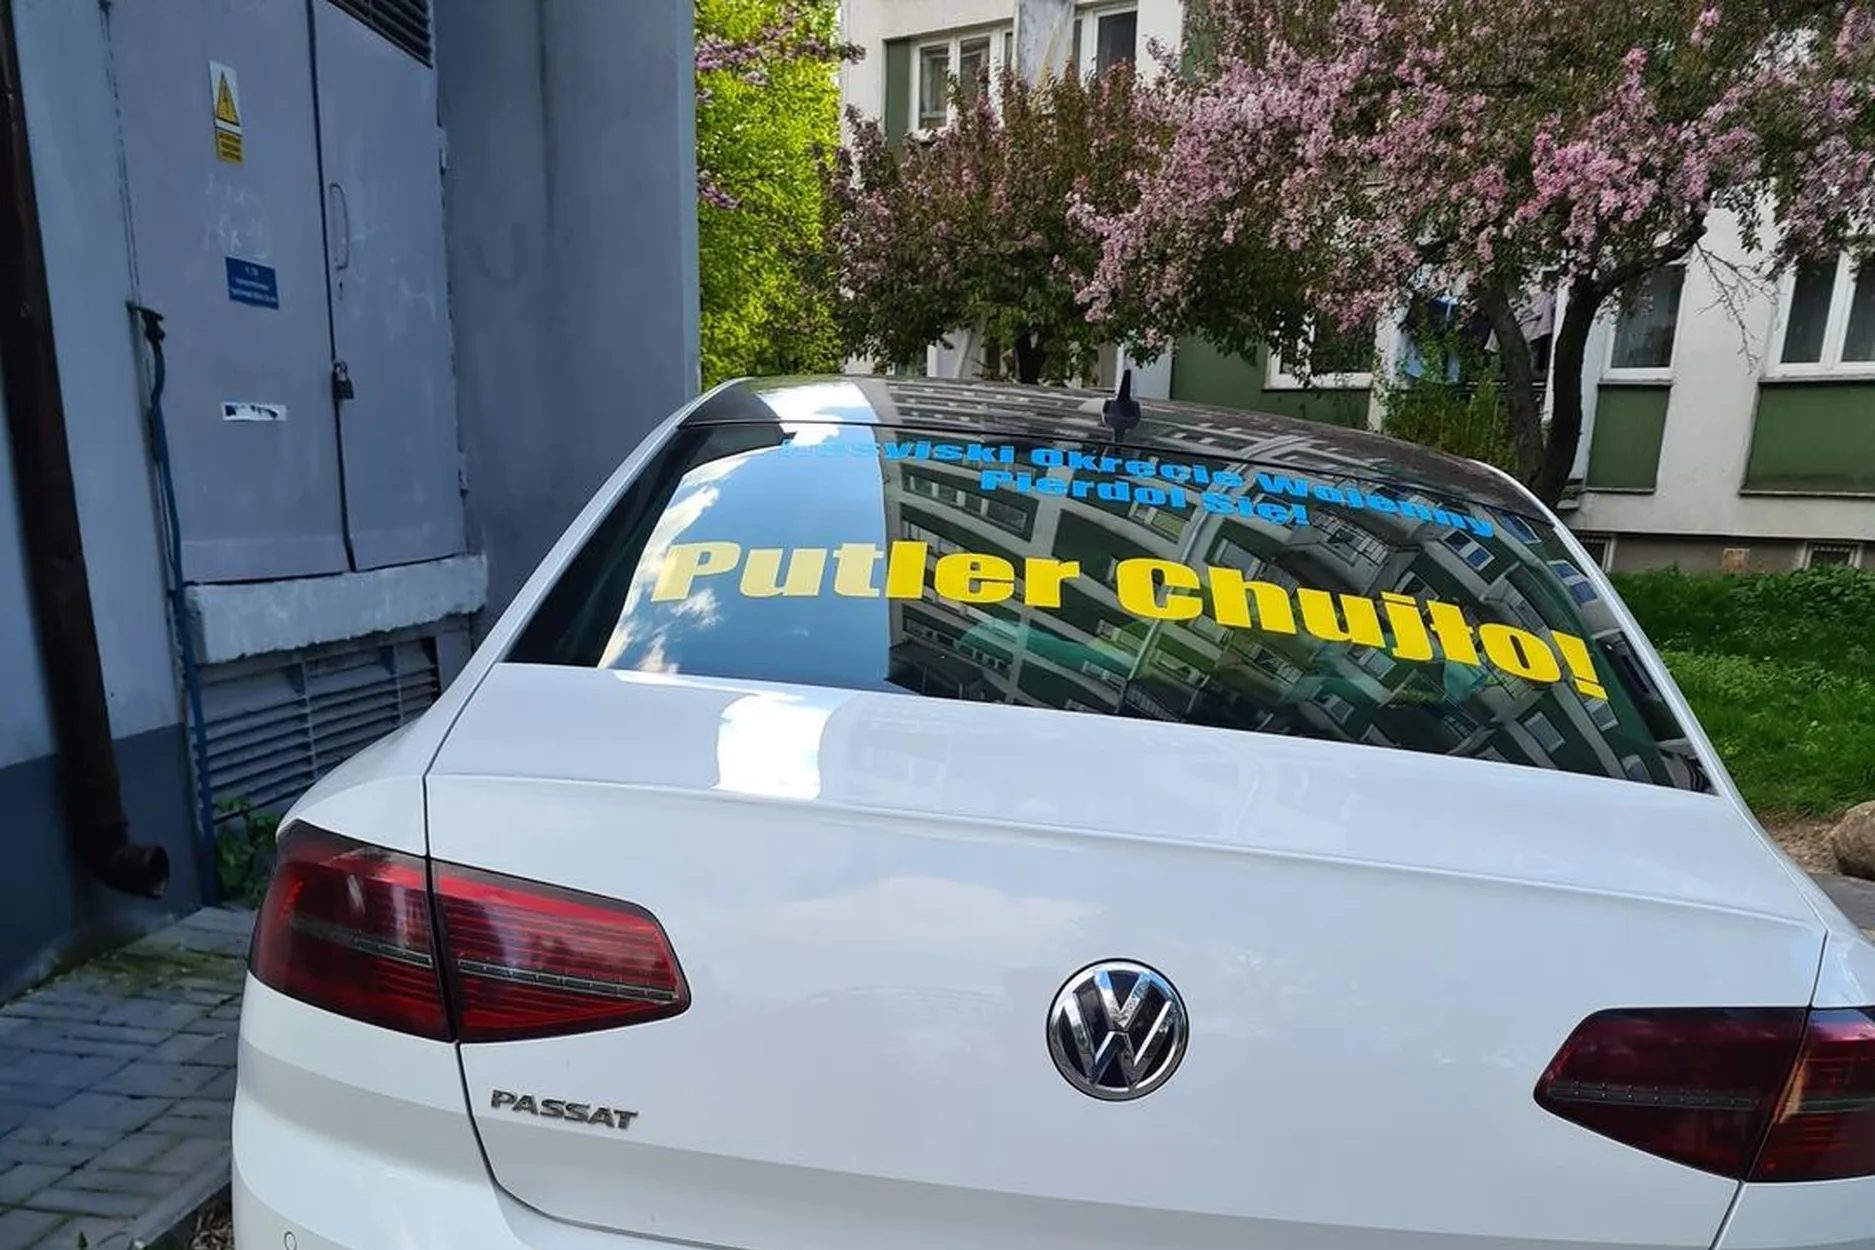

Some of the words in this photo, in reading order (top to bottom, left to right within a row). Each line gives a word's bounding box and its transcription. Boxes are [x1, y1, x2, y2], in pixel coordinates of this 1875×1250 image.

[978, 469, 1187, 508] Pierdol
[1255, 472, 1495, 538] Wojenny
[650, 540, 1082, 607] Putler
[490, 1089, 638, 1132] PASSAT
